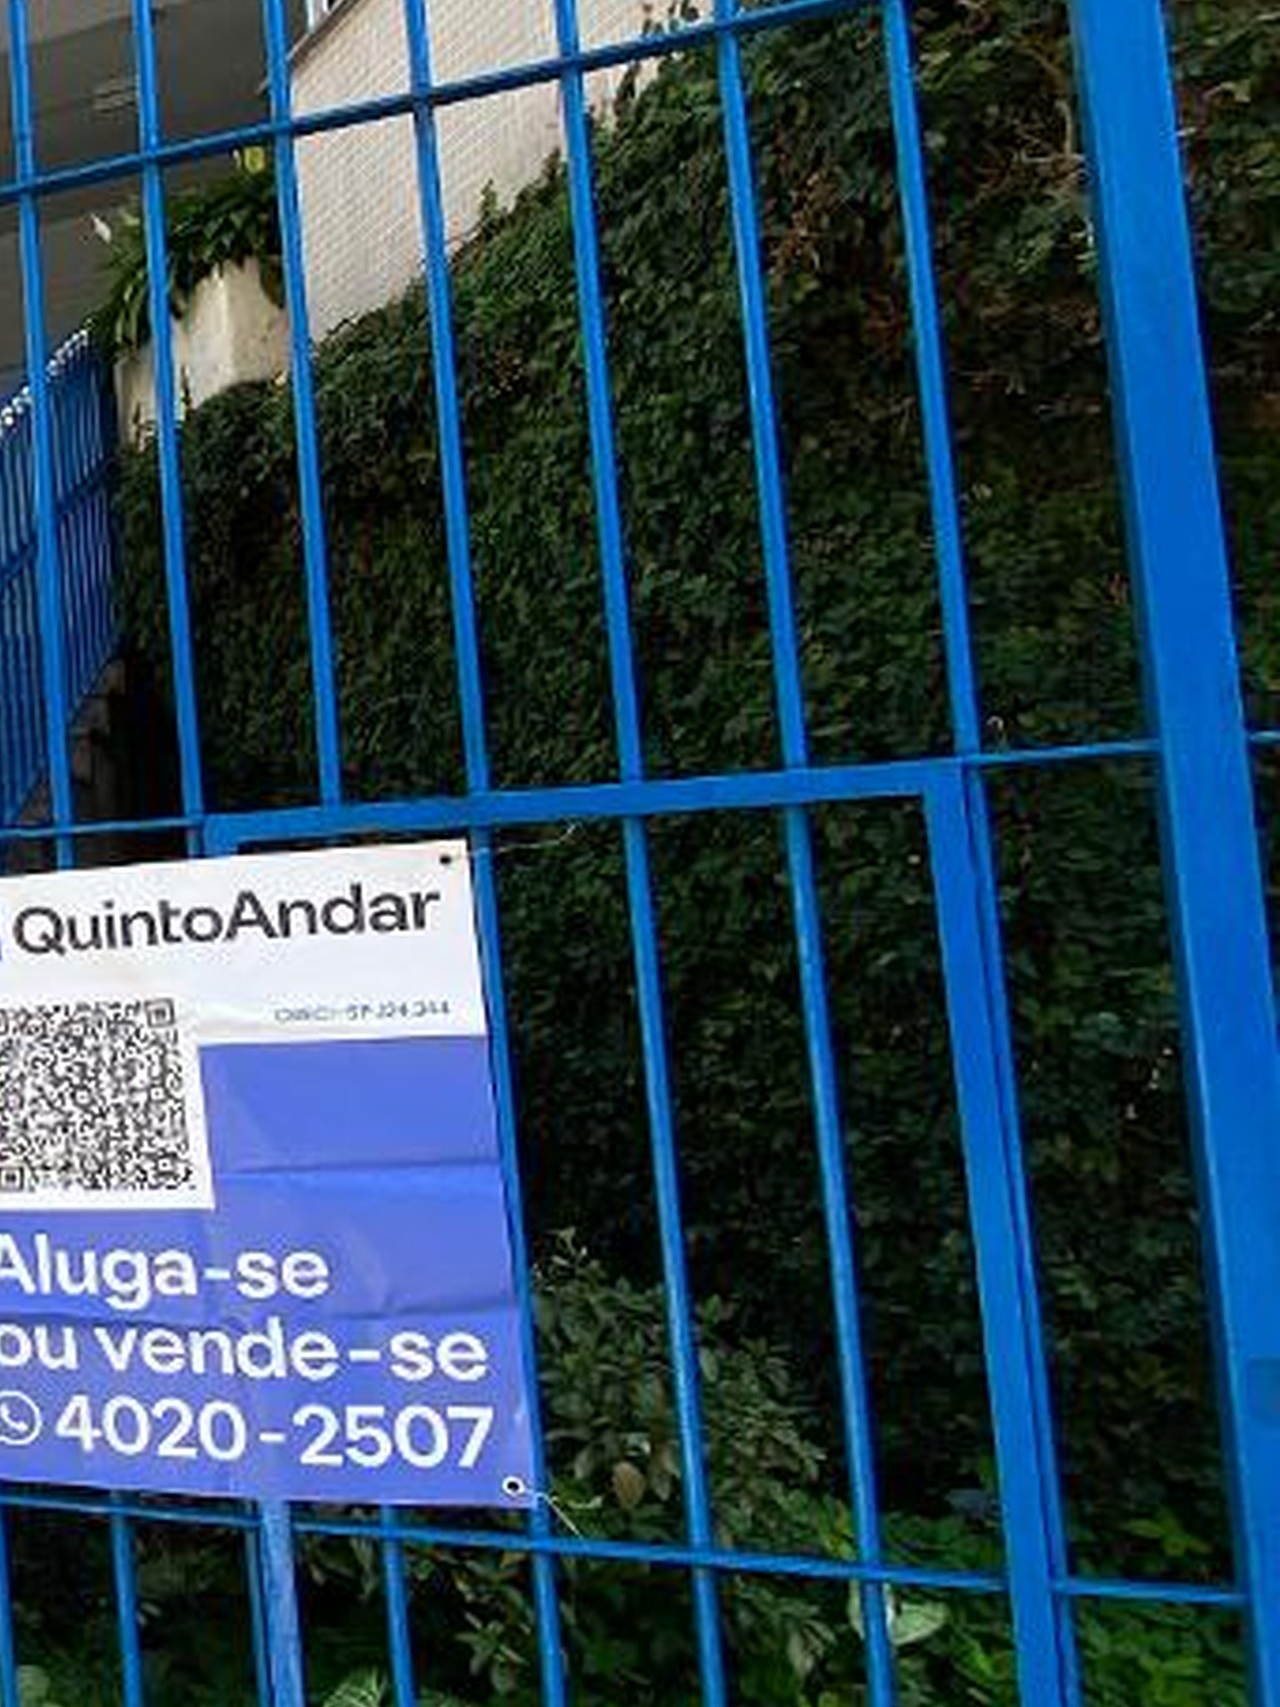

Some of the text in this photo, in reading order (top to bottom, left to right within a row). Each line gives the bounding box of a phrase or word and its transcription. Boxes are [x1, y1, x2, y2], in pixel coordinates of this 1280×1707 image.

[13, 883, 440, 956] QuintoAndar
[94, 1315, 488, 1382] vende-se
[55, 1394, 494, 1468] 4020-2507
